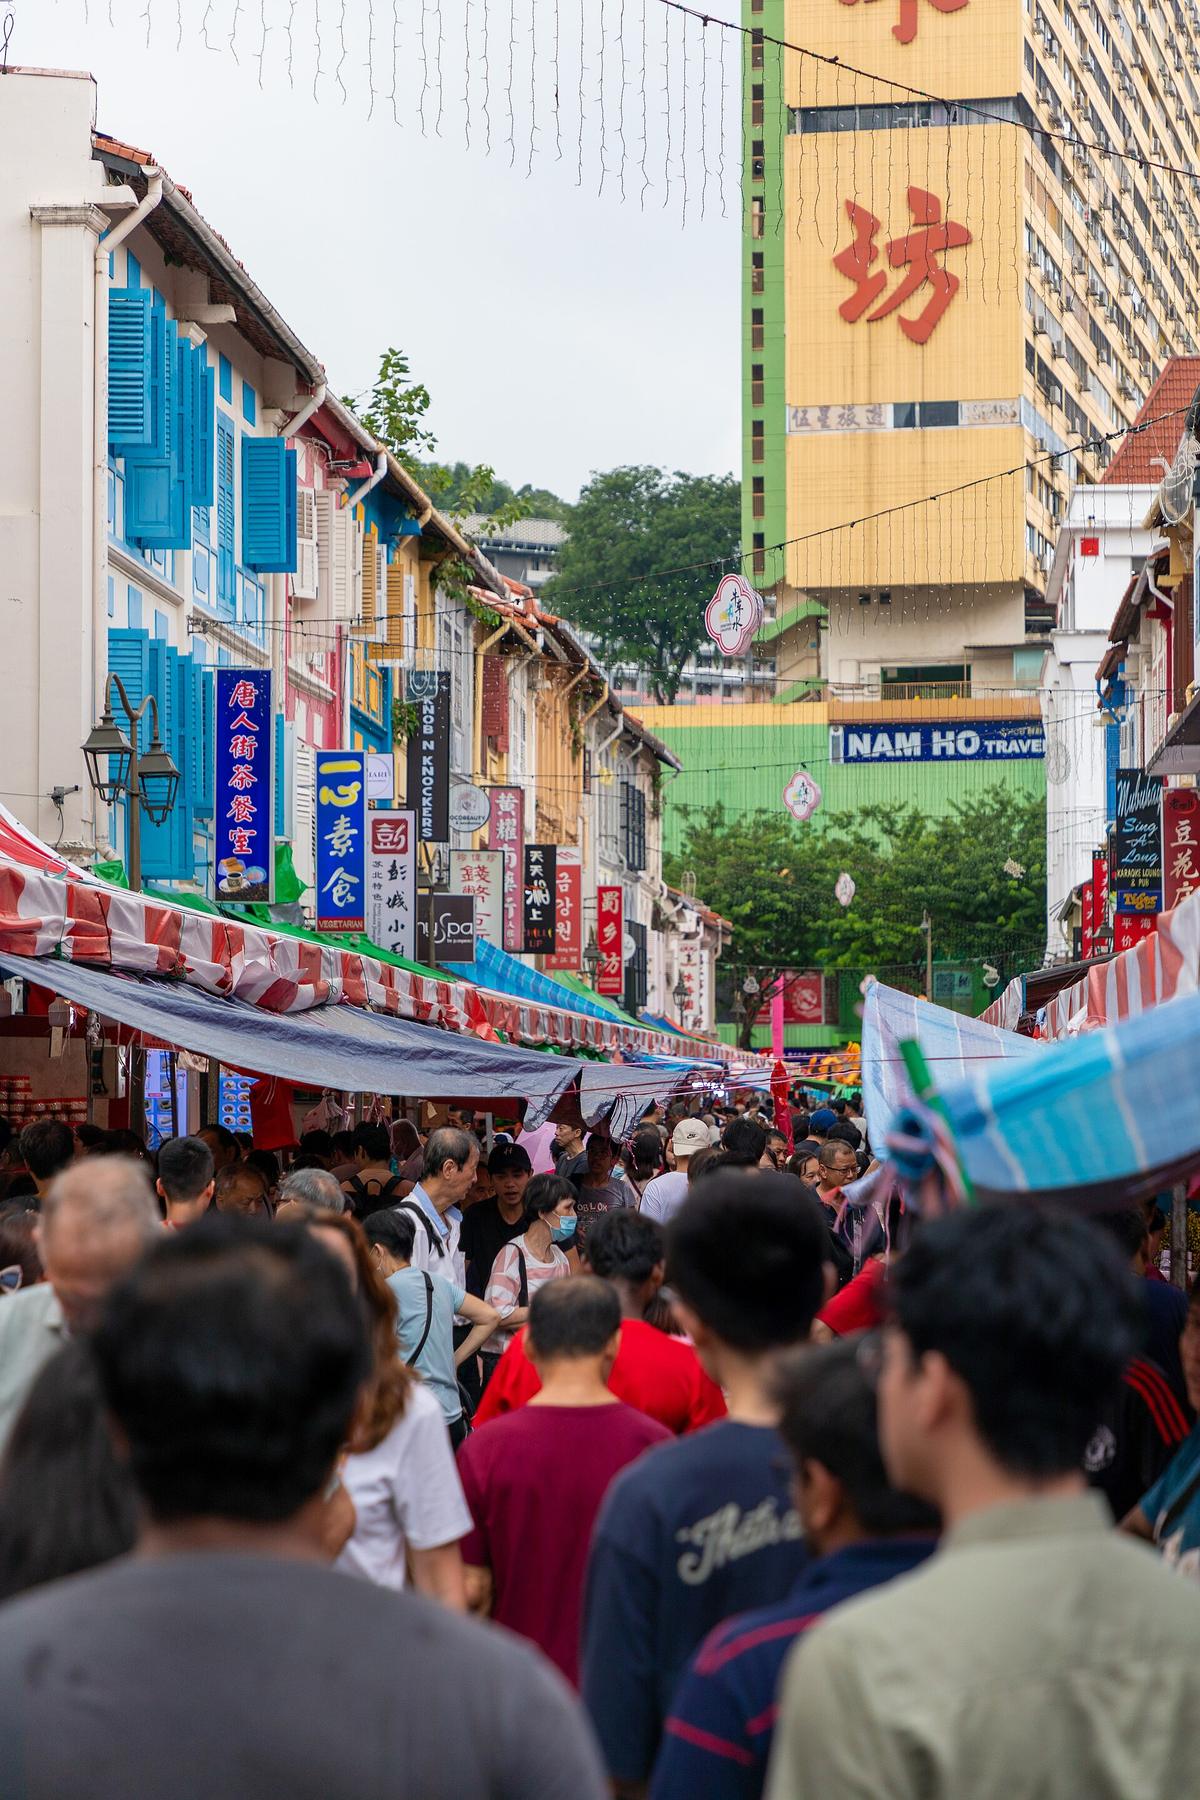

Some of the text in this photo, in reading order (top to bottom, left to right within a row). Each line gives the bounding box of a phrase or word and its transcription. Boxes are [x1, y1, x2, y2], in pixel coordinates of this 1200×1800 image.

[832, 185, 973, 345] 坊
[422, 740, 435, 751] N
[848, 731, 922, 758] NAM
[931, 729, 981, 757] HO
[226, 679, 260, 855] 唐人街茶餐室
[422, 755, 435, 838] KNOCKERS
[449, 814, 486, 822] OCOBEAUTY
[1122, 817, 1158, 837] Sing
[318, 759, 362, 908] 一心素食
[1122, 848, 1159, 867] Long
[1116, 868, 1161, 878] KARAOKE LOUNG
[1138, 878, 1150, 887] PUB
[556, 871, 573, 942] 금강원
[1123, 892, 1158, 910] Tiger
[318, 919, 363, 929] VEGETARIAN
[1140, 917, 1152, 940] 海
[577, 1202, 608, 1213] OBLOX
